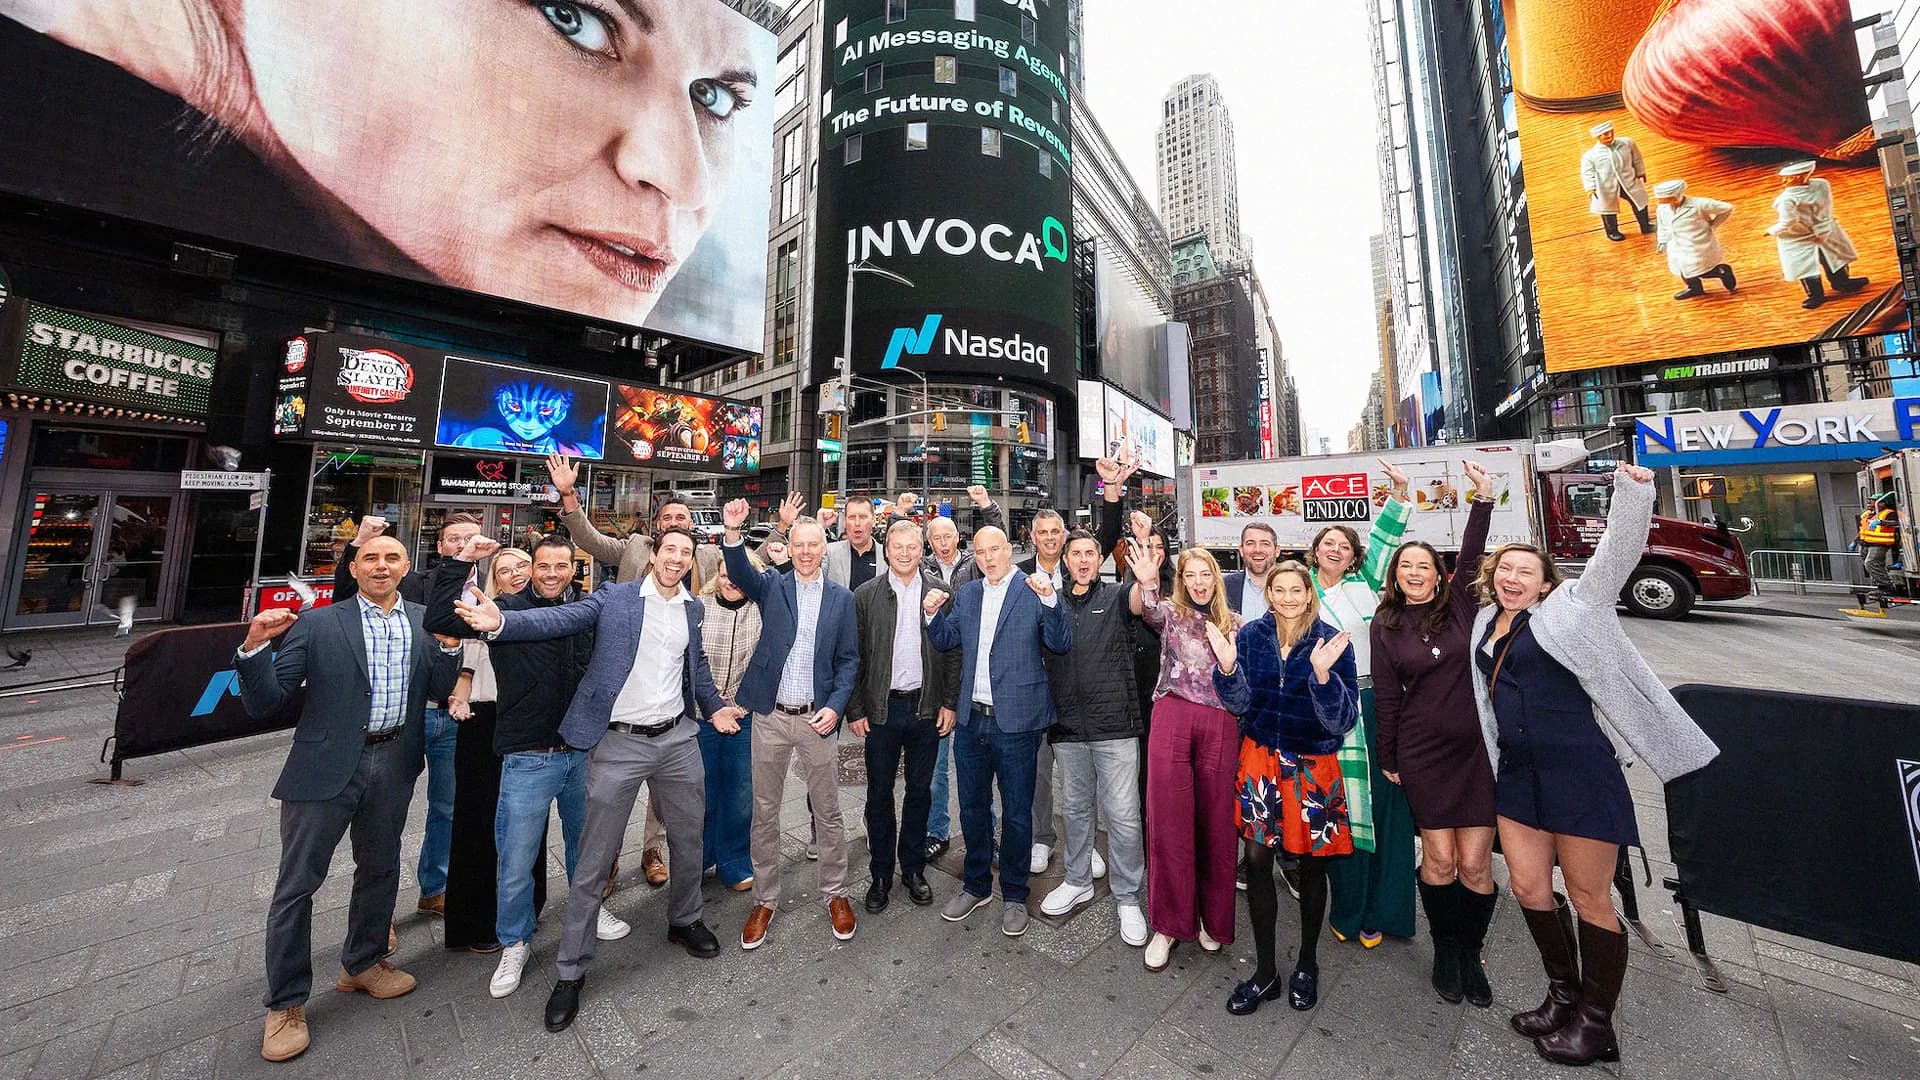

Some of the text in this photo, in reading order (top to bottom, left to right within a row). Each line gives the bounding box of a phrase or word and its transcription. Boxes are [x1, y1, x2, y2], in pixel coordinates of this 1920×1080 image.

[841, 41, 863, 66] AI
[869, 29, 1010, 59] Messaging
[831, 107, 869, 134] The
[874, 93, 969, 118] Future
[974, 100, 1003, 119] of
[847, 217, 1044, 272] INVOCA
[30, 322, 212, 380] STARBUCKS
[944, 328, 1049, 373] Nasdaq
[64, 359, 180, 398] COFFEE
[324, 406, 346, 416] Only
[347, 407, 356, 416] in
[325, 415, 414, 433] September 12
[508, 482, 532, 492] STORE
[1305, 476, 1366, 497] ACE
[1304, 499, 1367, 519] ENDICO
